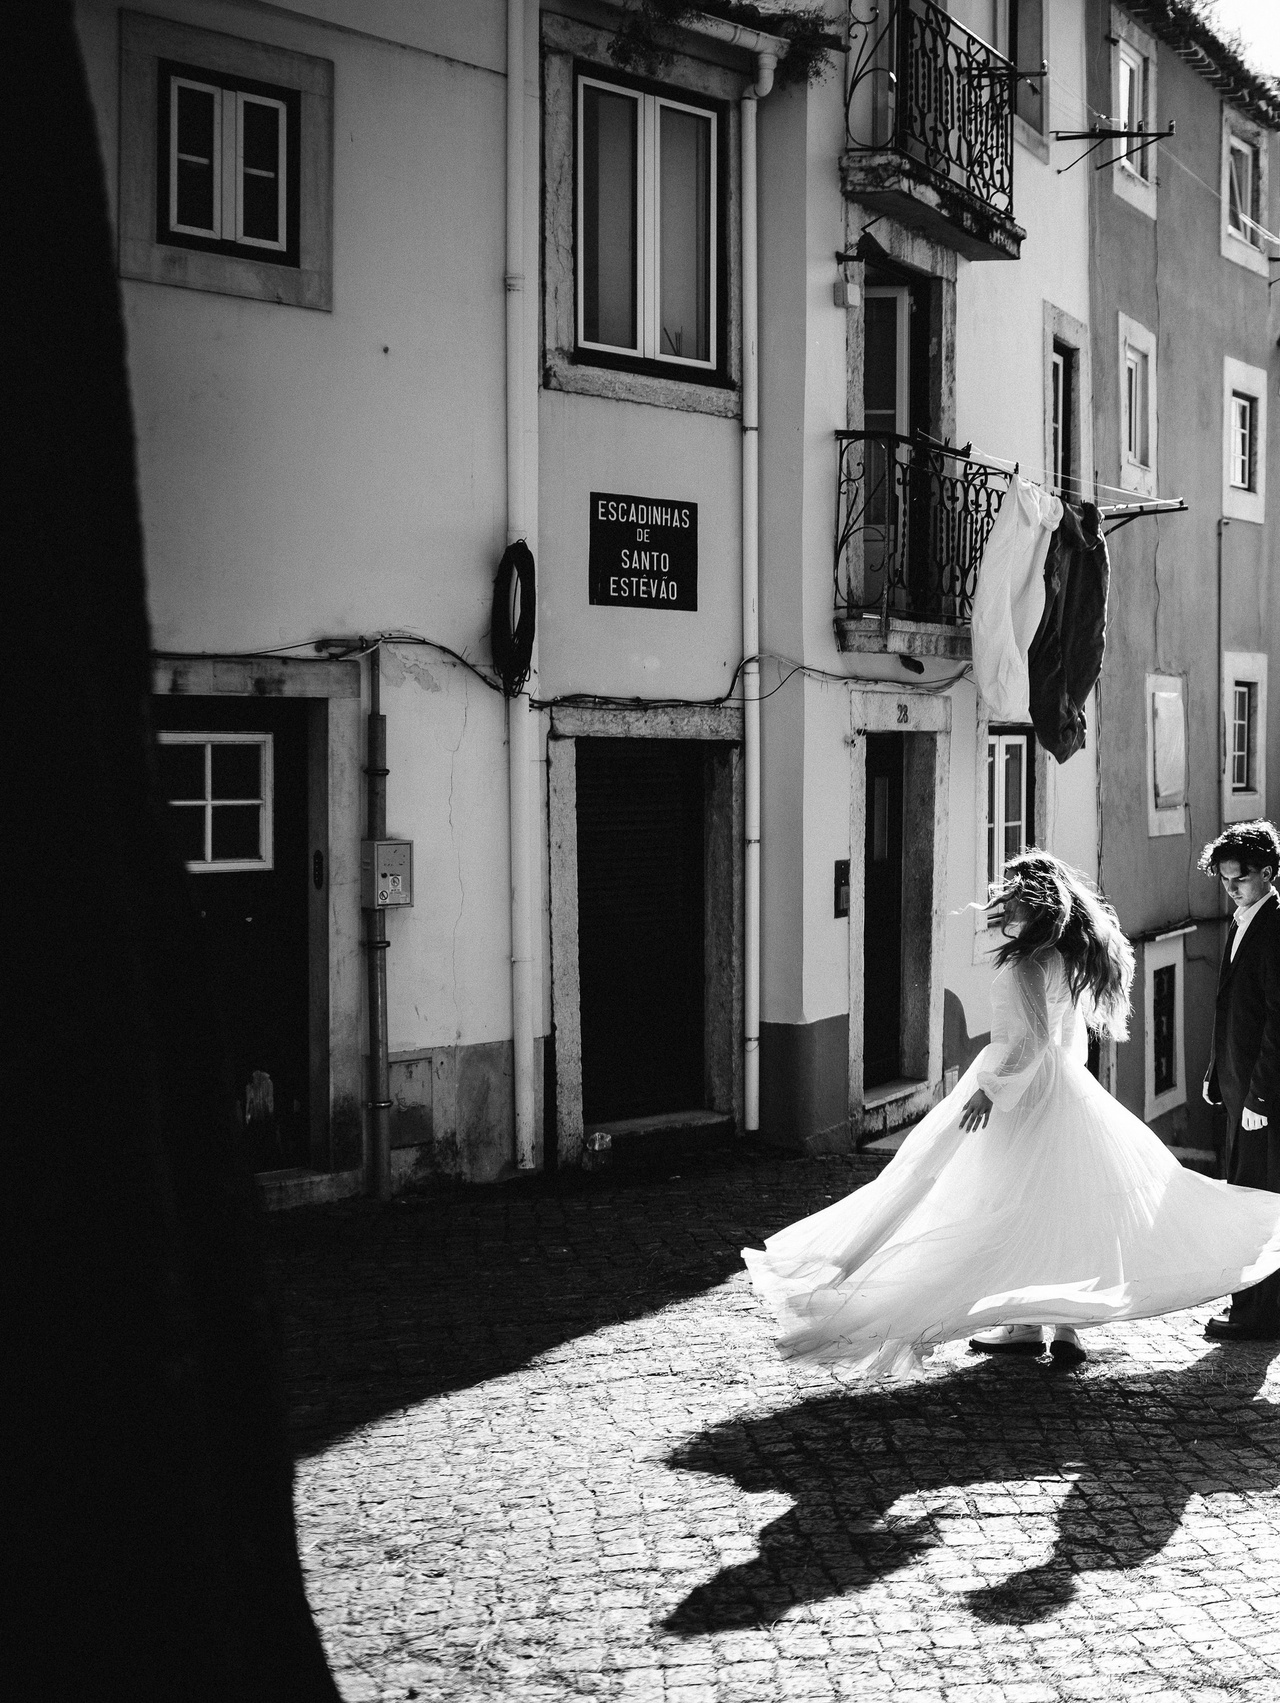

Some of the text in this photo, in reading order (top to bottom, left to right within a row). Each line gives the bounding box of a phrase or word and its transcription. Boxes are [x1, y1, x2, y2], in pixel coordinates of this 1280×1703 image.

[598, 500, 690, 528] ESCADINHAS
[636, 528, 650, 542] DE
[621, 549, 669, 572] SANTO
[610, 574, 677, 600] ESTÊVÃO
